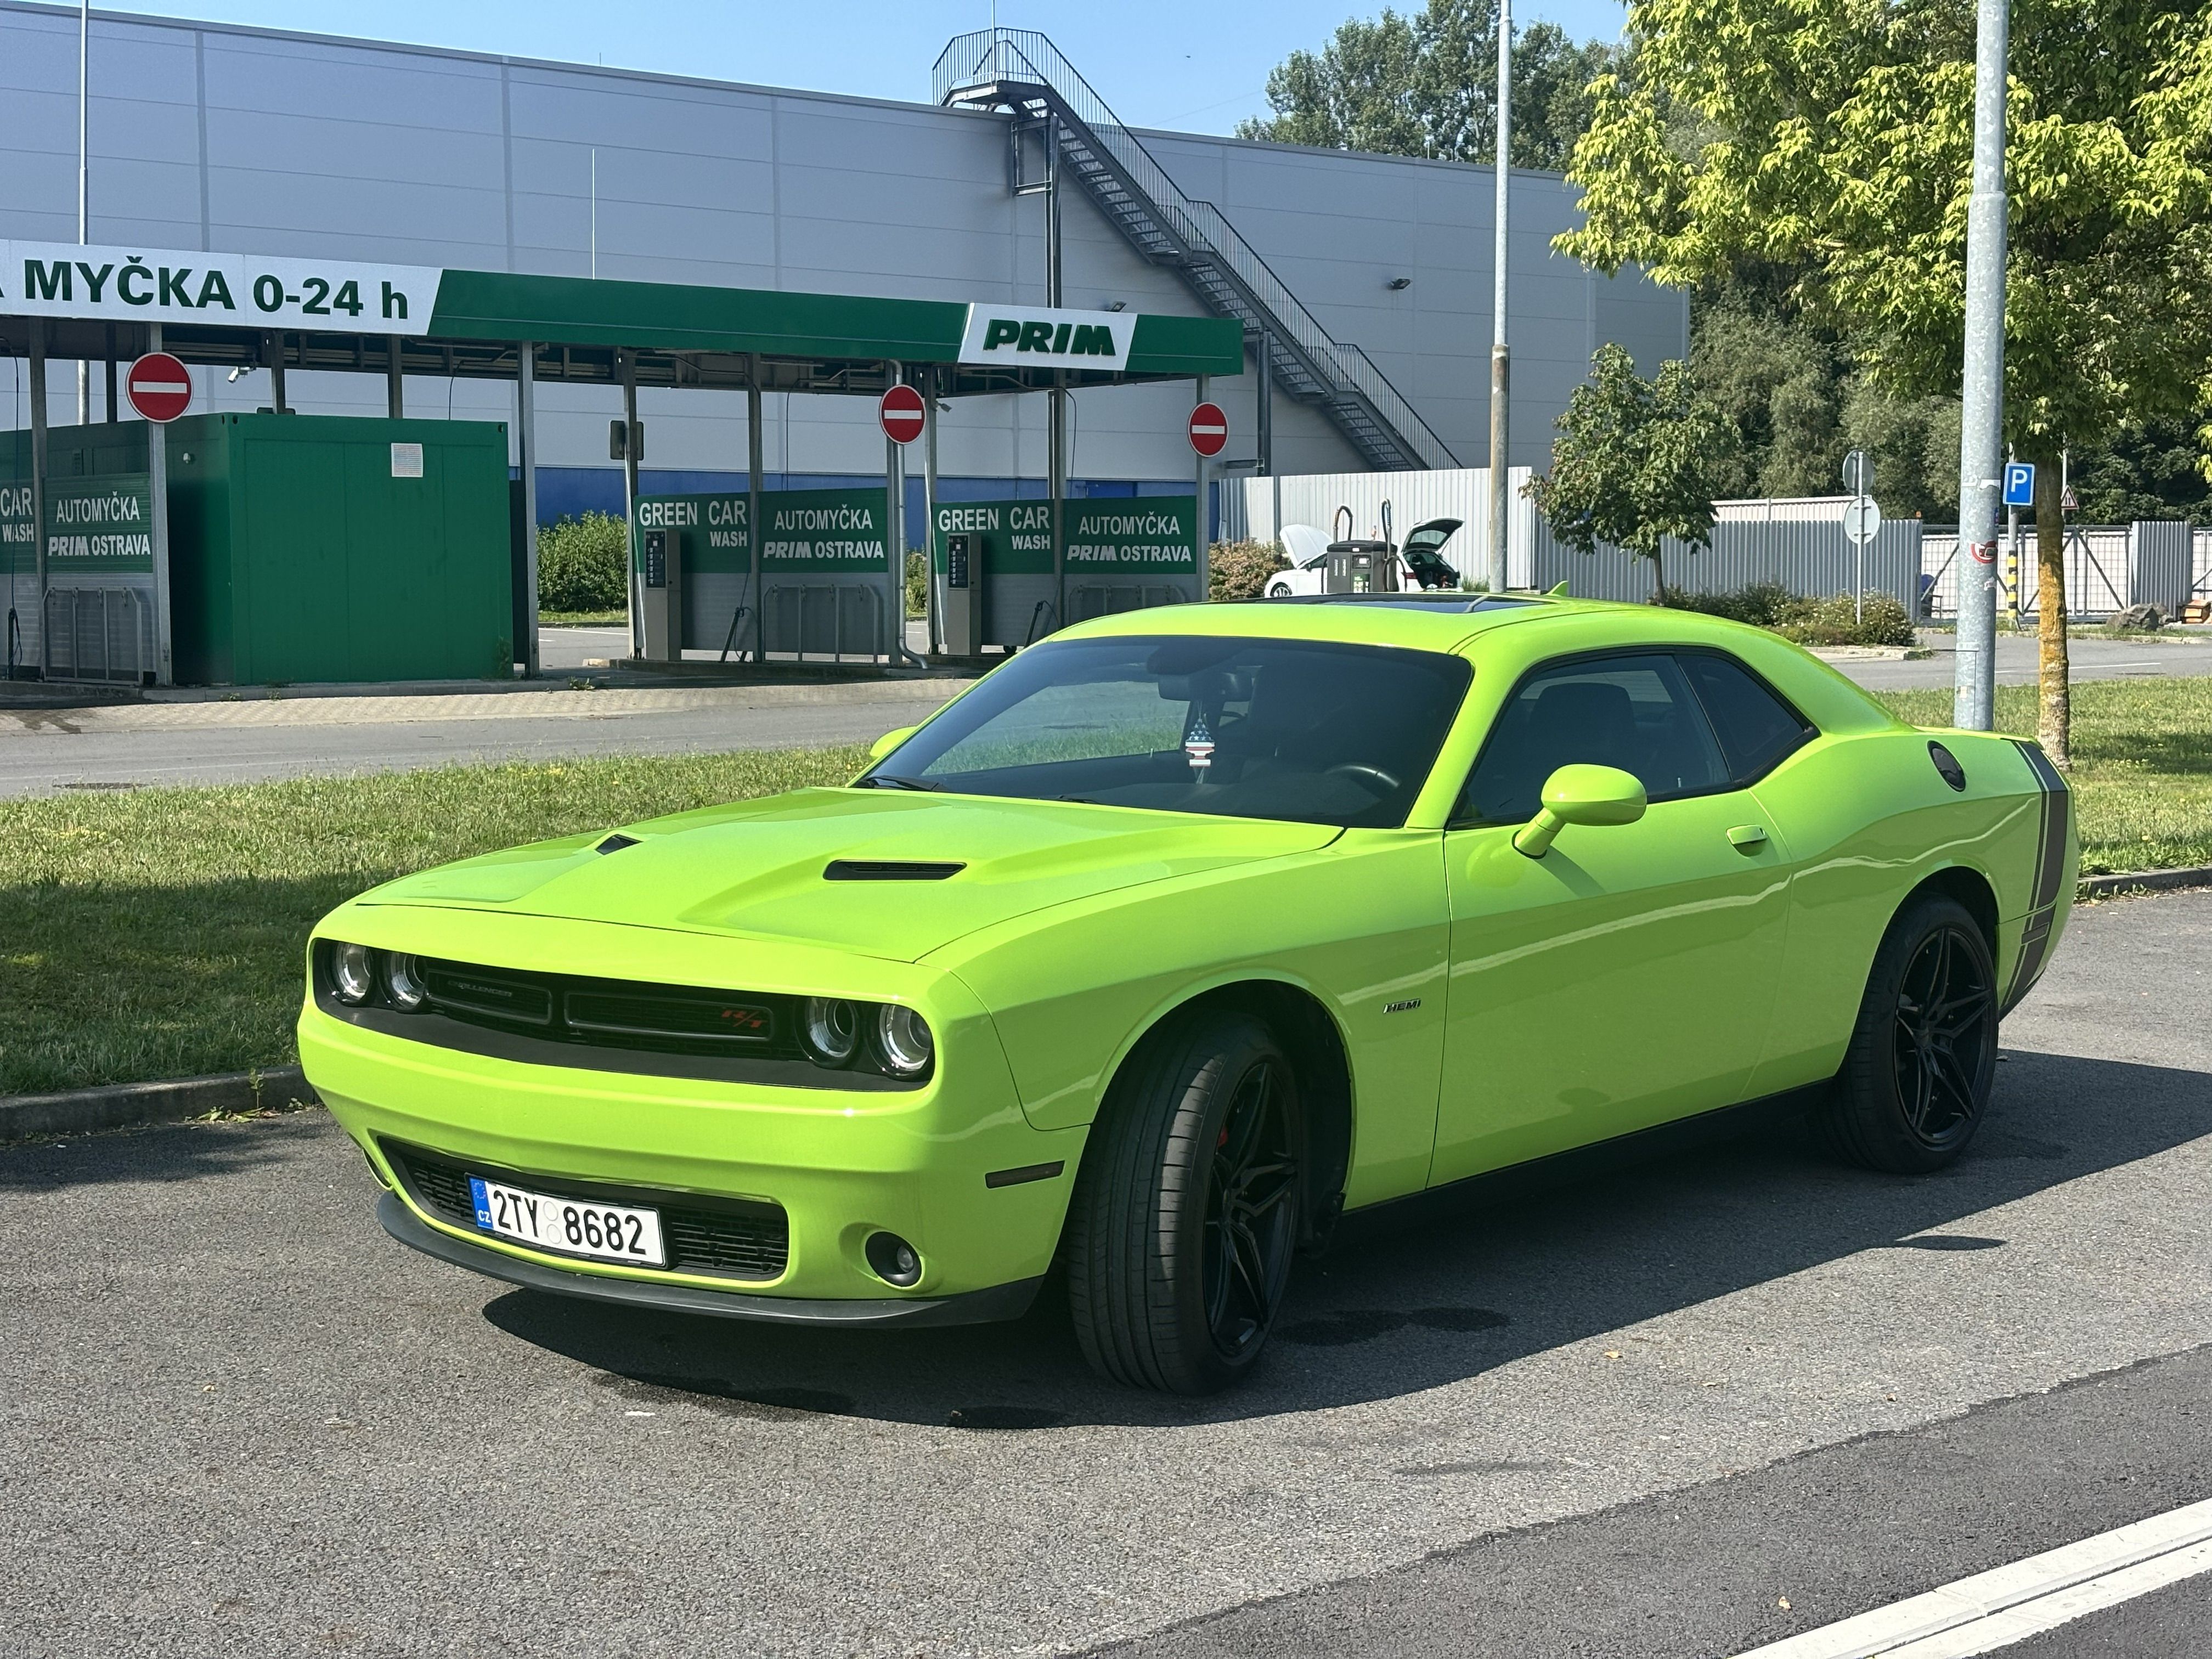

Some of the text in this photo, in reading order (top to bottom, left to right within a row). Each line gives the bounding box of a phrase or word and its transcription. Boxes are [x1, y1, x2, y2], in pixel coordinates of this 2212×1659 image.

[25, 256, 408, 319] MYČKA 0-24 h
[983, 319, 1116, 356] PRIM
[2011, 469, 2028, 493] P
[1, 488, 33, 517] CAR
[56, 491, 140, 523] AUTOMYČKA
[639, 500, 747, 526] GREEN CAR
[774, 504, 873, 531] AUTOMYČKA
[938, 506, 1050, 532] GREEN CAR
[1079, 511, 1180, 535] AUTOMYČKA
[2, 523, 34, 542] WASH
[710, 531, 747, 547] WASH
[1011, 535, 1051, 550] WASH
[48, 534, 151, 556] PRIM OSTRAVA
[763, 541, 884, 558] PRIM OSTRAVA
[1066, 545, 1192, 562] PRIM OSTRAVA
[1383, 998, 1421, 1014] HEMI
[478, 1210, 492, 1223] CZ
[494, 1190, 647, 1255] 2TY 8682
